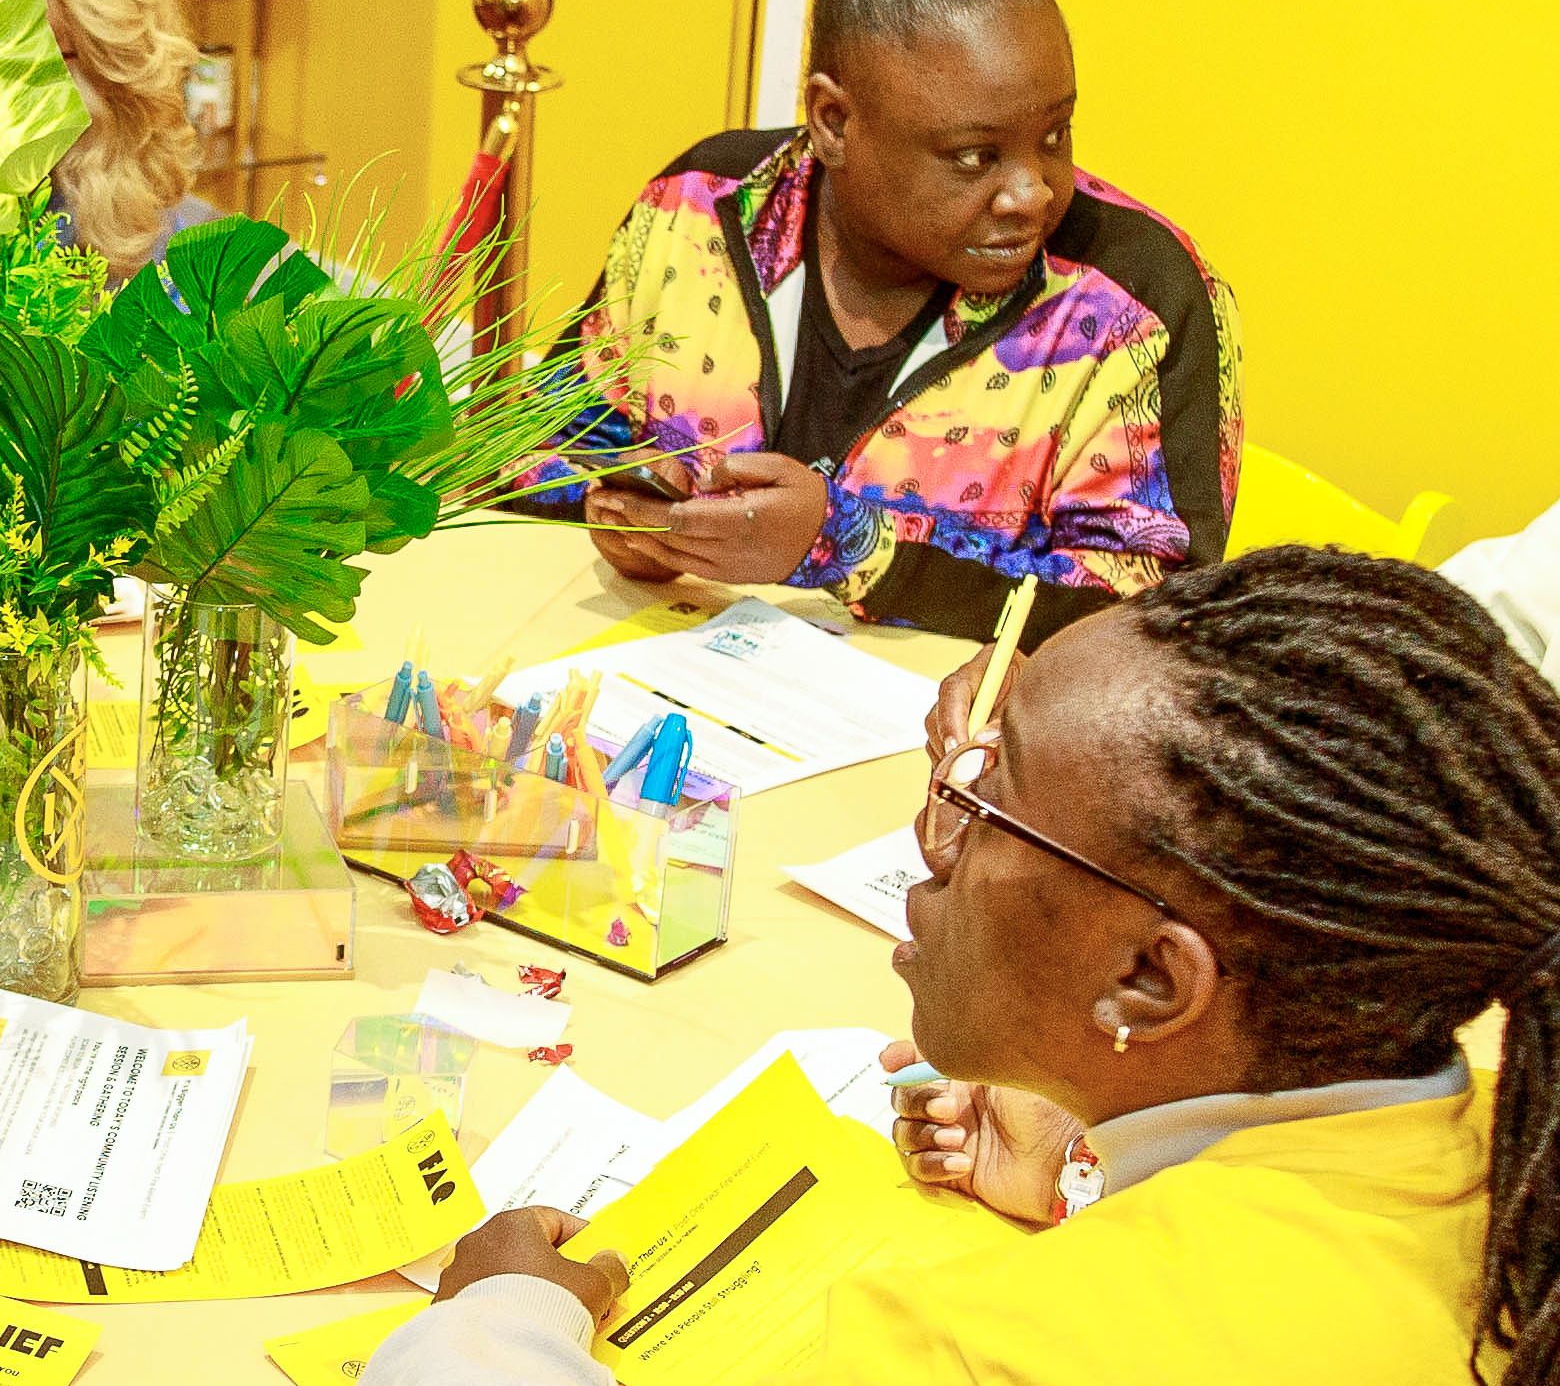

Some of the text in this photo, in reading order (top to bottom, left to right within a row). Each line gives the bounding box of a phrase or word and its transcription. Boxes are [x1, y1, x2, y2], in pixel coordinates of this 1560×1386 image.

[109, 1045, 127, 1074] SESSION
[89, 1084, 113, 1126] GATHERING
[76, 1048, 147, 1220] WELCOME TO TODAY'S COMMUNITY LISTENING
[418, 1150, 456, 1205] FAQ
[639, 1245, 657, 1261] Than
[618, 1319, 645, 1343] QUESTION
[639, 1338, 665, 1361] Where
[679, 1307, 704, 1330] People
[717, 1261, 762, 1300] Struggling?
